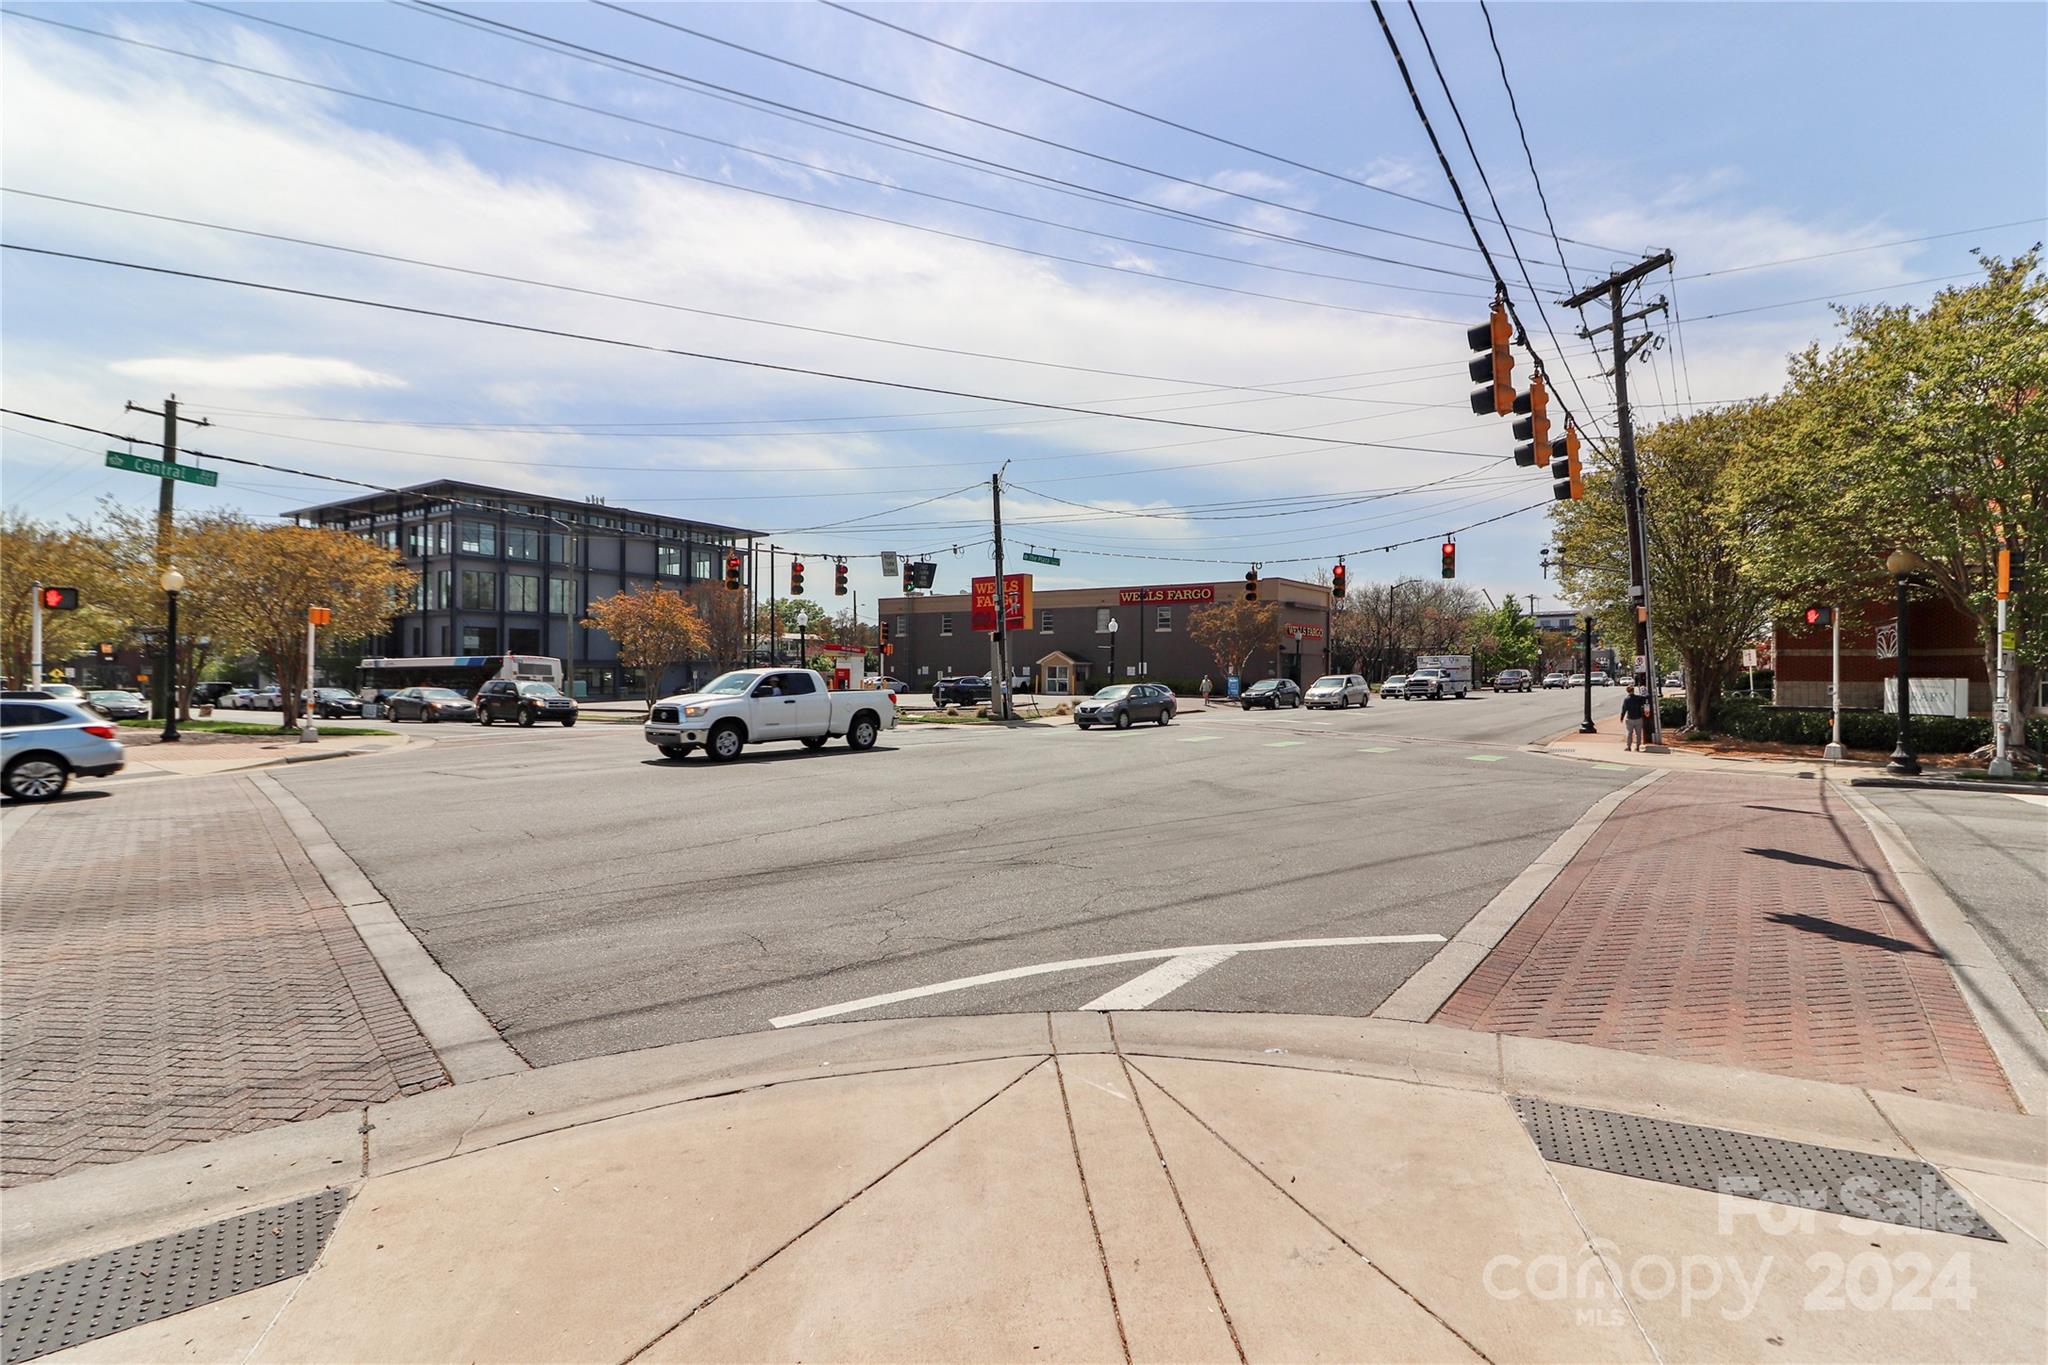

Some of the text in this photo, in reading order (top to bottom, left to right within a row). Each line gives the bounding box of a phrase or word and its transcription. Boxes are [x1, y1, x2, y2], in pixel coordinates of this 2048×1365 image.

[133, 459, 186, 479] Central
[975, 580, 1019, 594] WELS
[1167, 588, 1212, 601] FARGO
